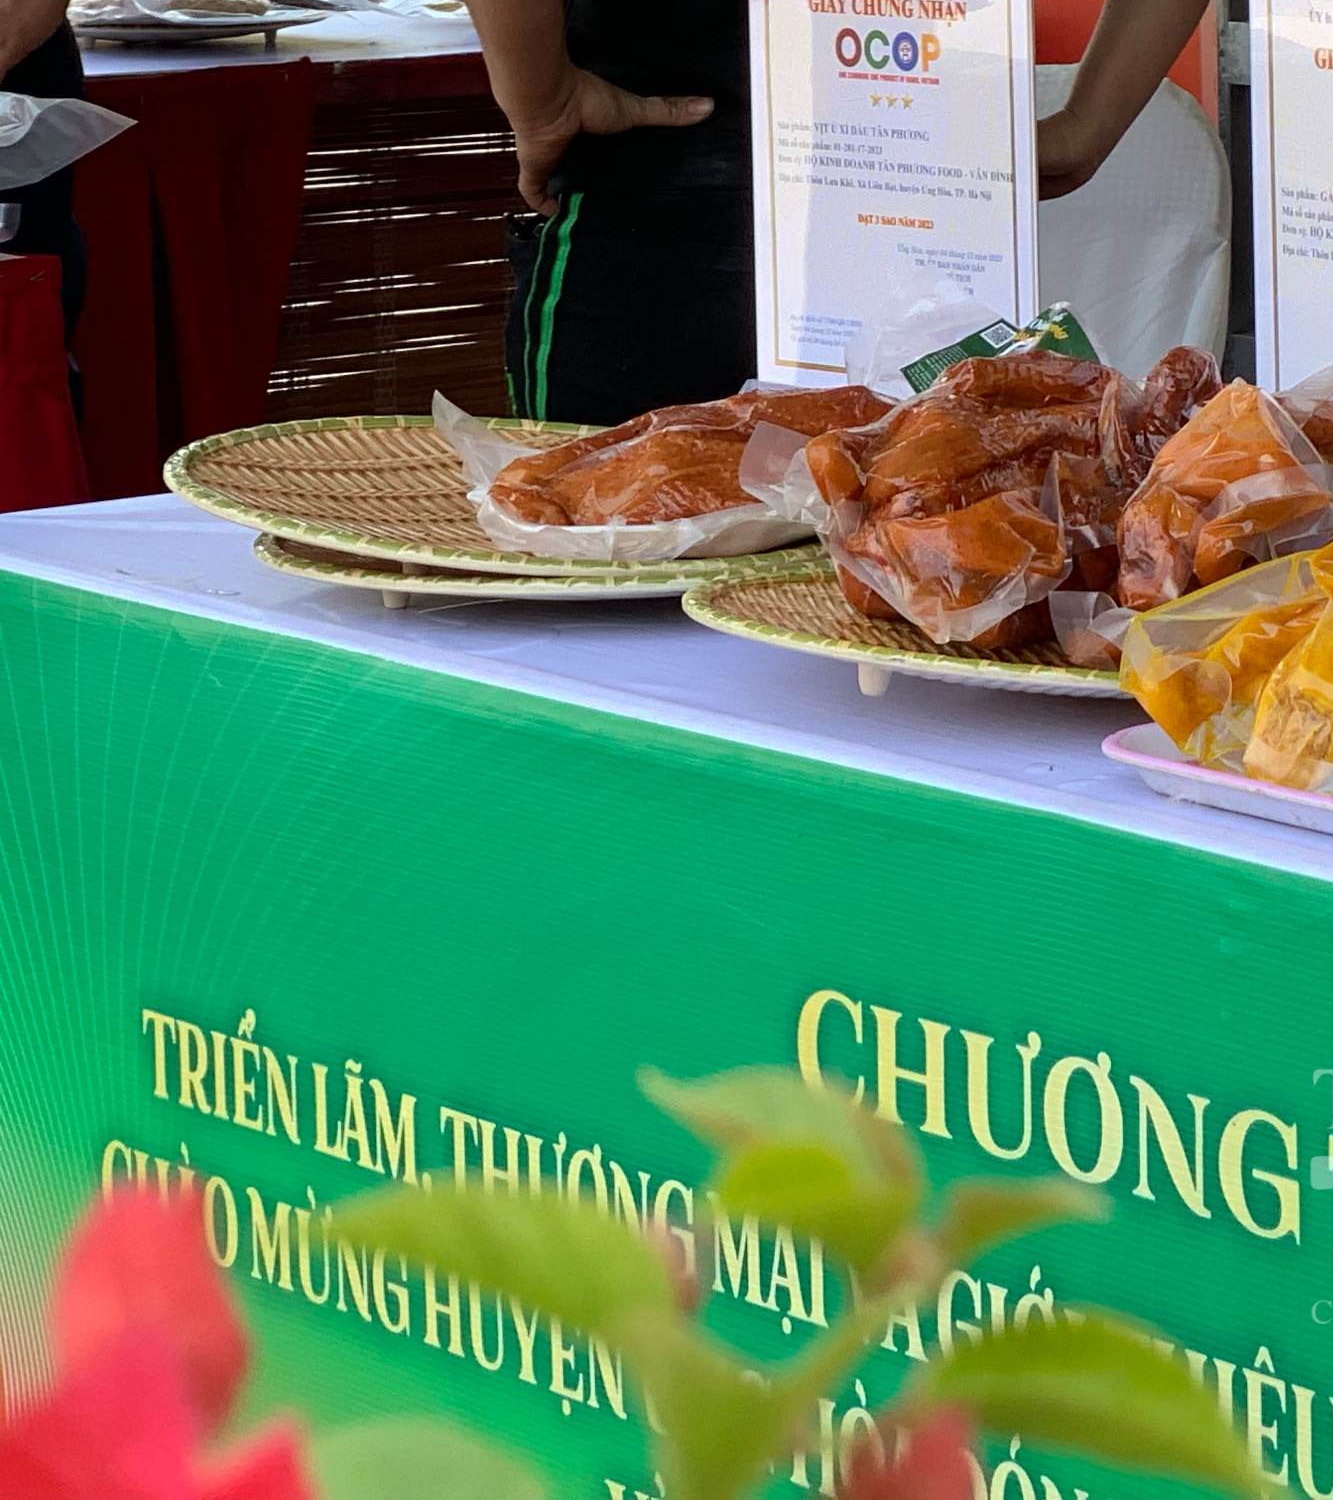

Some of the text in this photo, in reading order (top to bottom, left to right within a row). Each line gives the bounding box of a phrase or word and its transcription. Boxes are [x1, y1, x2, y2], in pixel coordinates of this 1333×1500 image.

[835, 27, 941, 72] OCOP
[141, 1008, 302, 1147] TRIỂN
[796, 988, 1302, 1246] CHƯƠNG
